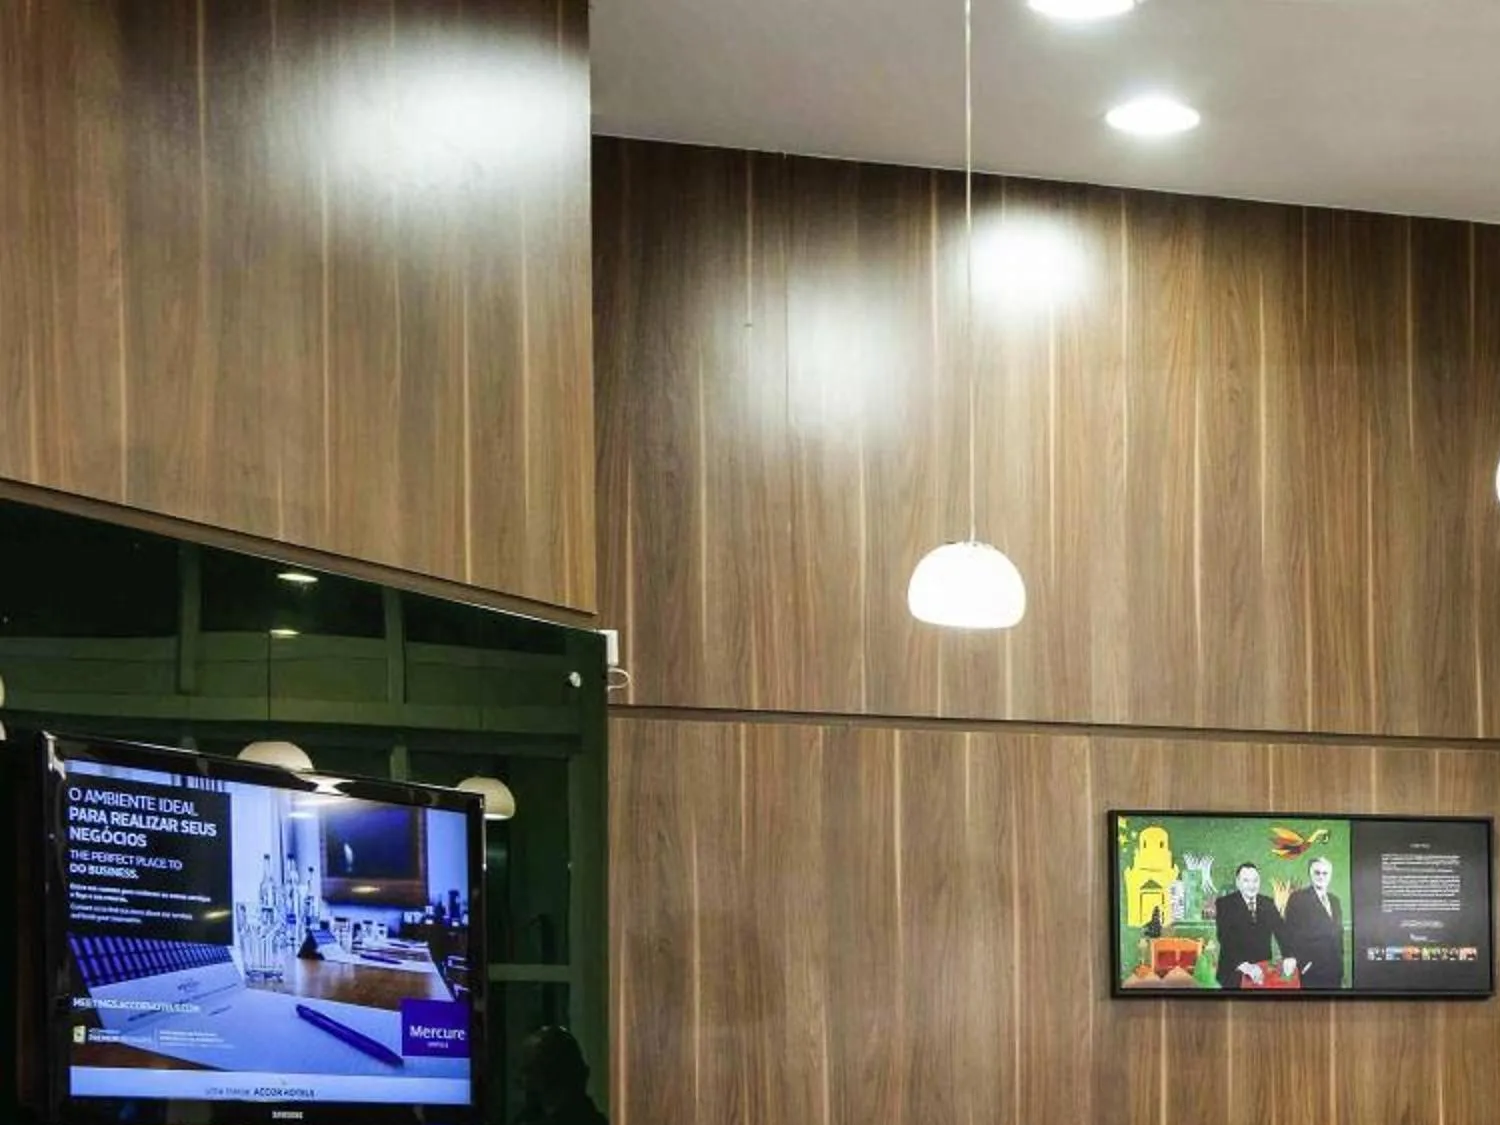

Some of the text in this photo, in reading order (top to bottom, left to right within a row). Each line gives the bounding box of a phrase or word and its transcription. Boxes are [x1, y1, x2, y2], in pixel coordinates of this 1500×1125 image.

[69, 787, 199, 817] O AMBIENTE IDEAL
[69, 806, 217, 837] PARA REALIZAR SEUS
[69, 826, 148, 848] NEGÓCIOS
[69, 863, 87, 874] DO
[70, 849, 183, 871] THE PERFECT PLACE TO
[409, 1024, 466, 1041] Mercure
